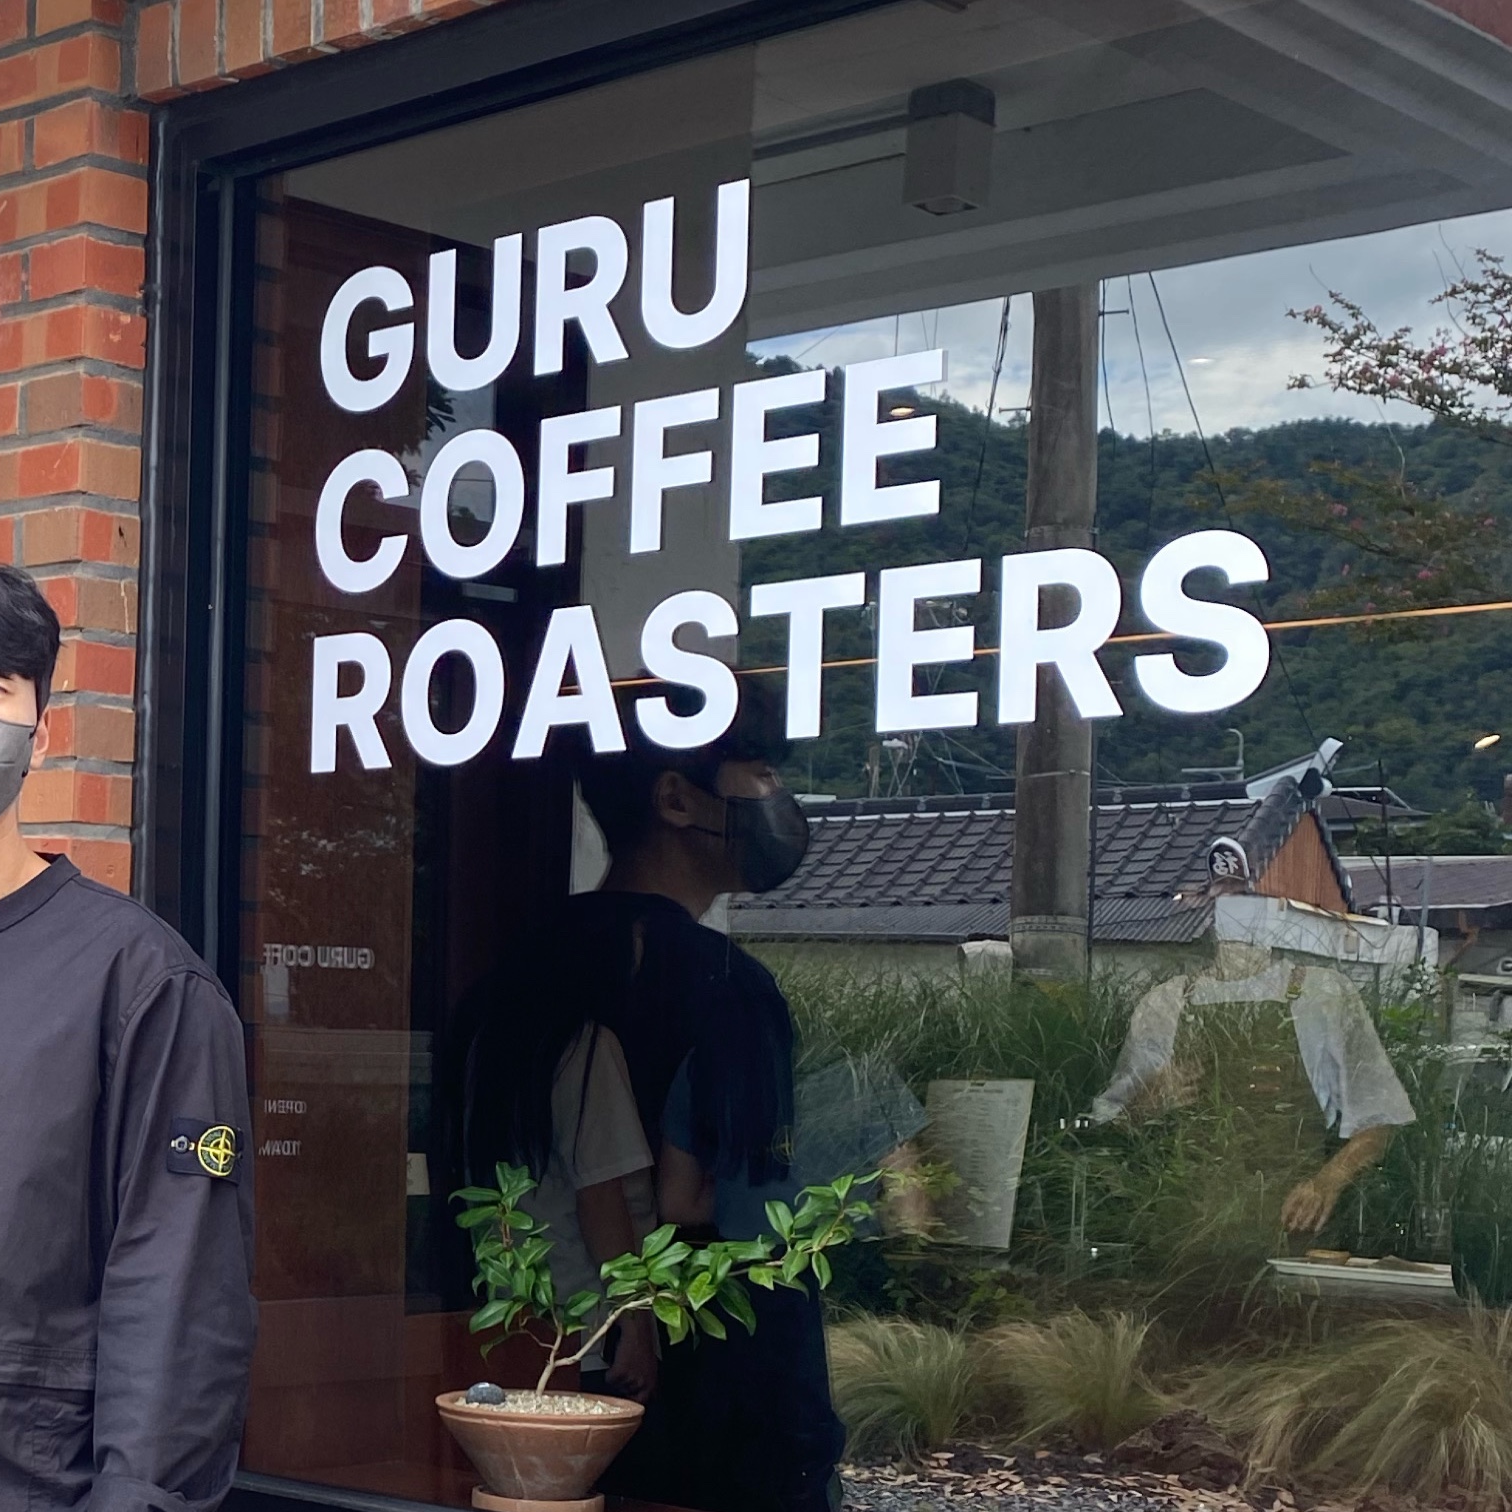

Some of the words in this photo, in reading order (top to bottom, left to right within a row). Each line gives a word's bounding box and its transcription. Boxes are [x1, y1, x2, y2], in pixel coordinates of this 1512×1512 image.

[320, 178, 750, 413] GURU
[315, 348, 947, 594] COFFEE
[310, 530, 1271, 774] ROASTERS
